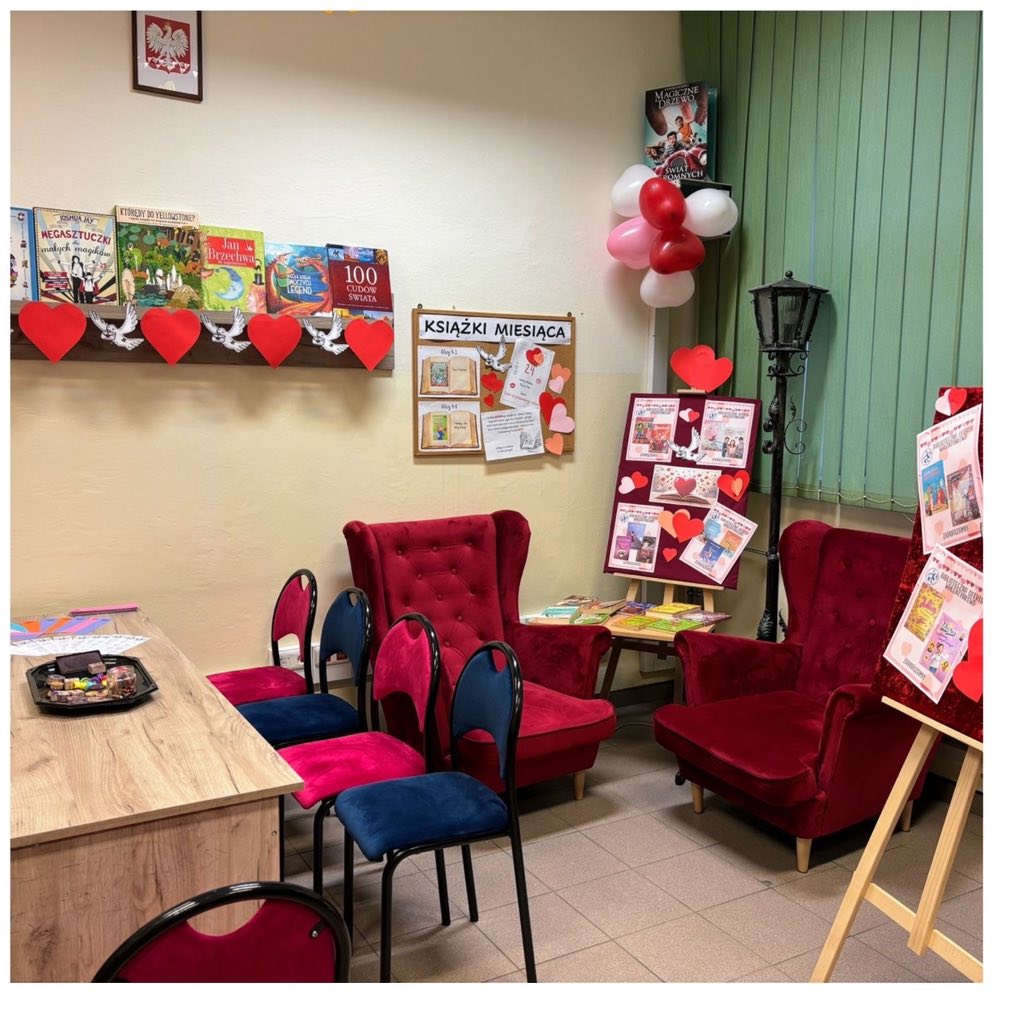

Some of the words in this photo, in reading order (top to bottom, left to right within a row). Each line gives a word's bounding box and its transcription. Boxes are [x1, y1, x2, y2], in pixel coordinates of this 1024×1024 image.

[655, 85, 699, 101] MAGICZNE
[658, 94, 695, 109] DRZEWO
[59, 215, 82, 223] JOSHUA
[82, 216, 95, 225] JAY
[119, 207, 146, 218] KTÓRĘDY
[146, 209, 155, 219] DO
[155, 210, 196, 223] YELLOWSTONE?
[41, 228, 111, 246] MEGASZTUCZKI
[221, 237, 240, 251] Jan
[41, 242, 71, 255] małych
[74, 243, 112, 258] magików
[208, 248, 256, 264] Brzechwa
[344, 264, 378, 286] 100
[287, 285, 313, 295] LEGEND
[346, 284, 377, 294] CUDÓW
[348, 292, 378, 303] ŚWIATA
[424, 318, 488, 338] KSIĄŻKI
[494, 323, 566, 339] MIESIĄCA
